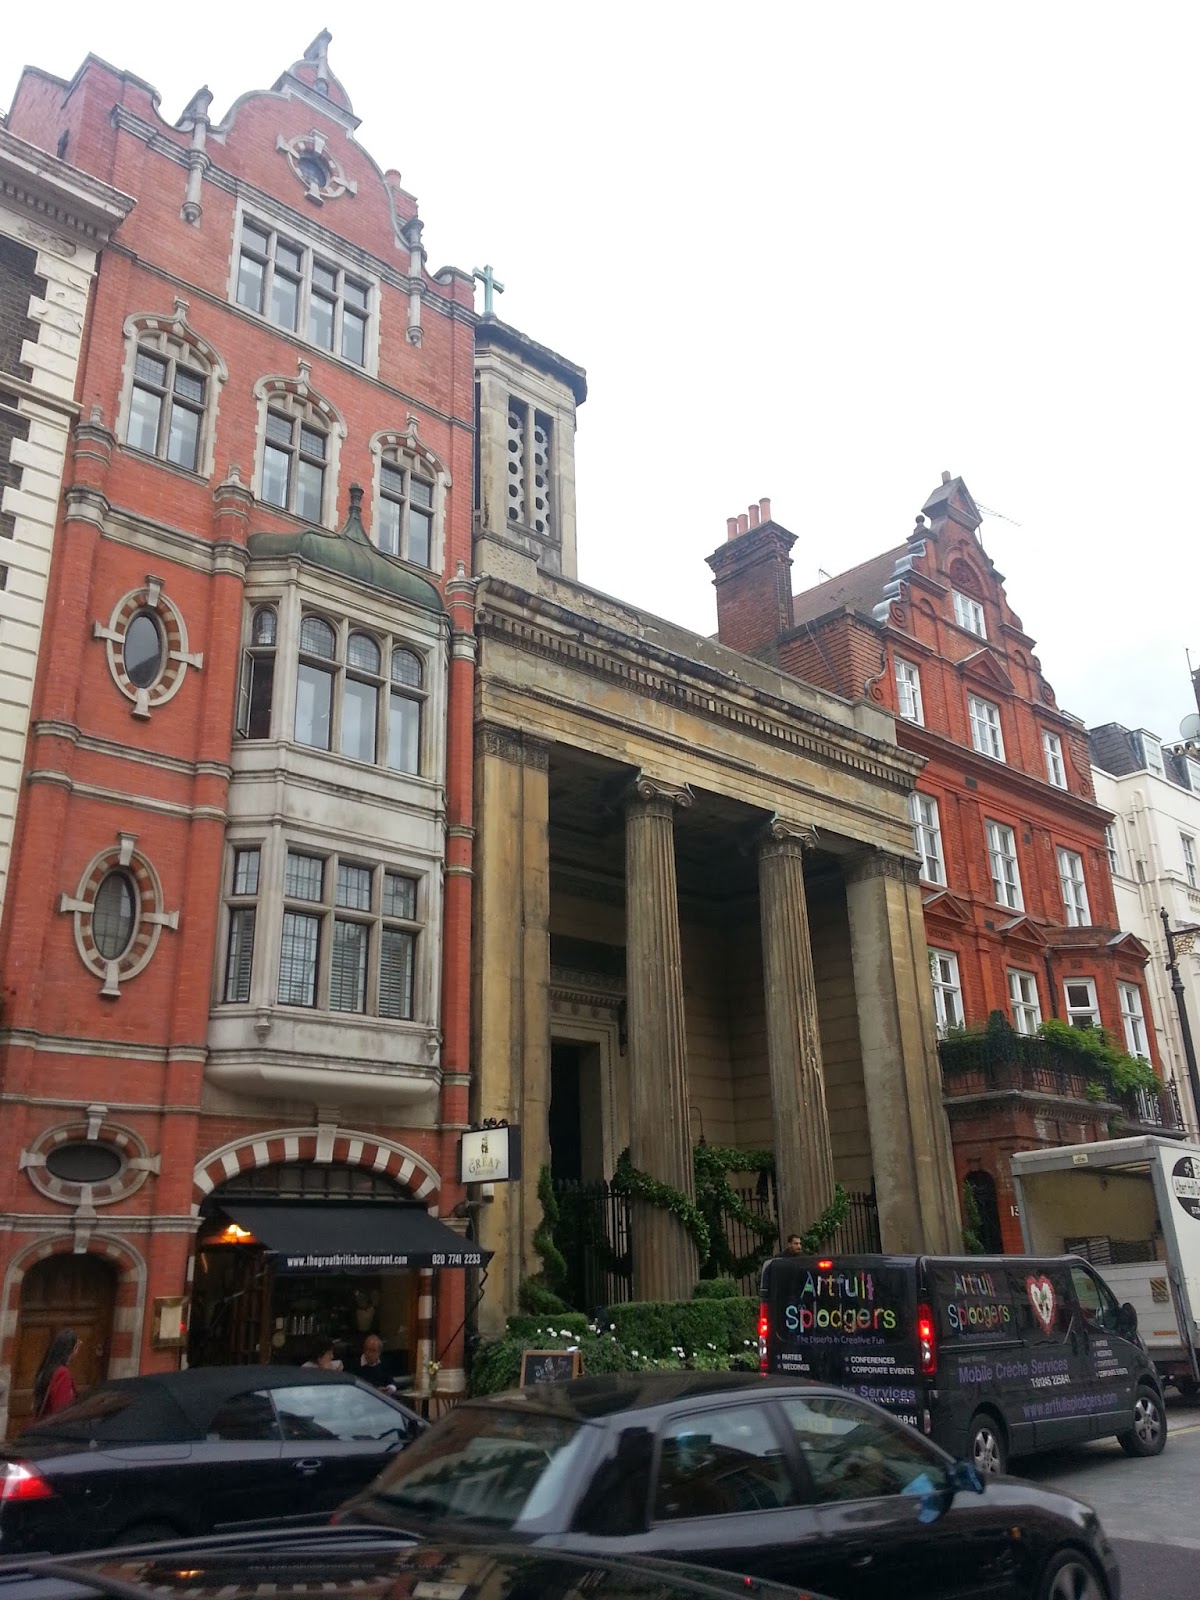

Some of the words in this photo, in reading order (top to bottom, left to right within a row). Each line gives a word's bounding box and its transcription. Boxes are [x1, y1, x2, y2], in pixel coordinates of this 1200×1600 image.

[469, 1157, 501, 1174] GREAT
[287, 1253, 407, 1268] www.thegreatbritishrestaurant.com
[432, 1253, 446, 1265] 020
[448, 1253, 462, 1265] 7741
[464, 1253, 481, 1265] 2233
[800, 1270, 875, 1301] Artfull
[785, 1300, 897, 1334] Splodgers
[947, 1299, 1011, 1331] Splodgers
[841, 1335, 871, 1345] Creative
[872, 1336, 885, 1345] Fun
[781, 1353, 803, 1361] PARTIES
[850, 1355, 896, 1364] CONFERENCES
[782, 1363, 810, 1371] WEDDINGS
[851, 1366, 888, 1375] CORPORATE
[889, 1367, 915, 1375] EVENTS
[958, 1366, 992, 1384] Mobile
[1031, 1358, 1069, 1375] Services
[859, 1385, 916, 1399] Services
[892, 1414, 918, 1425] 5841
